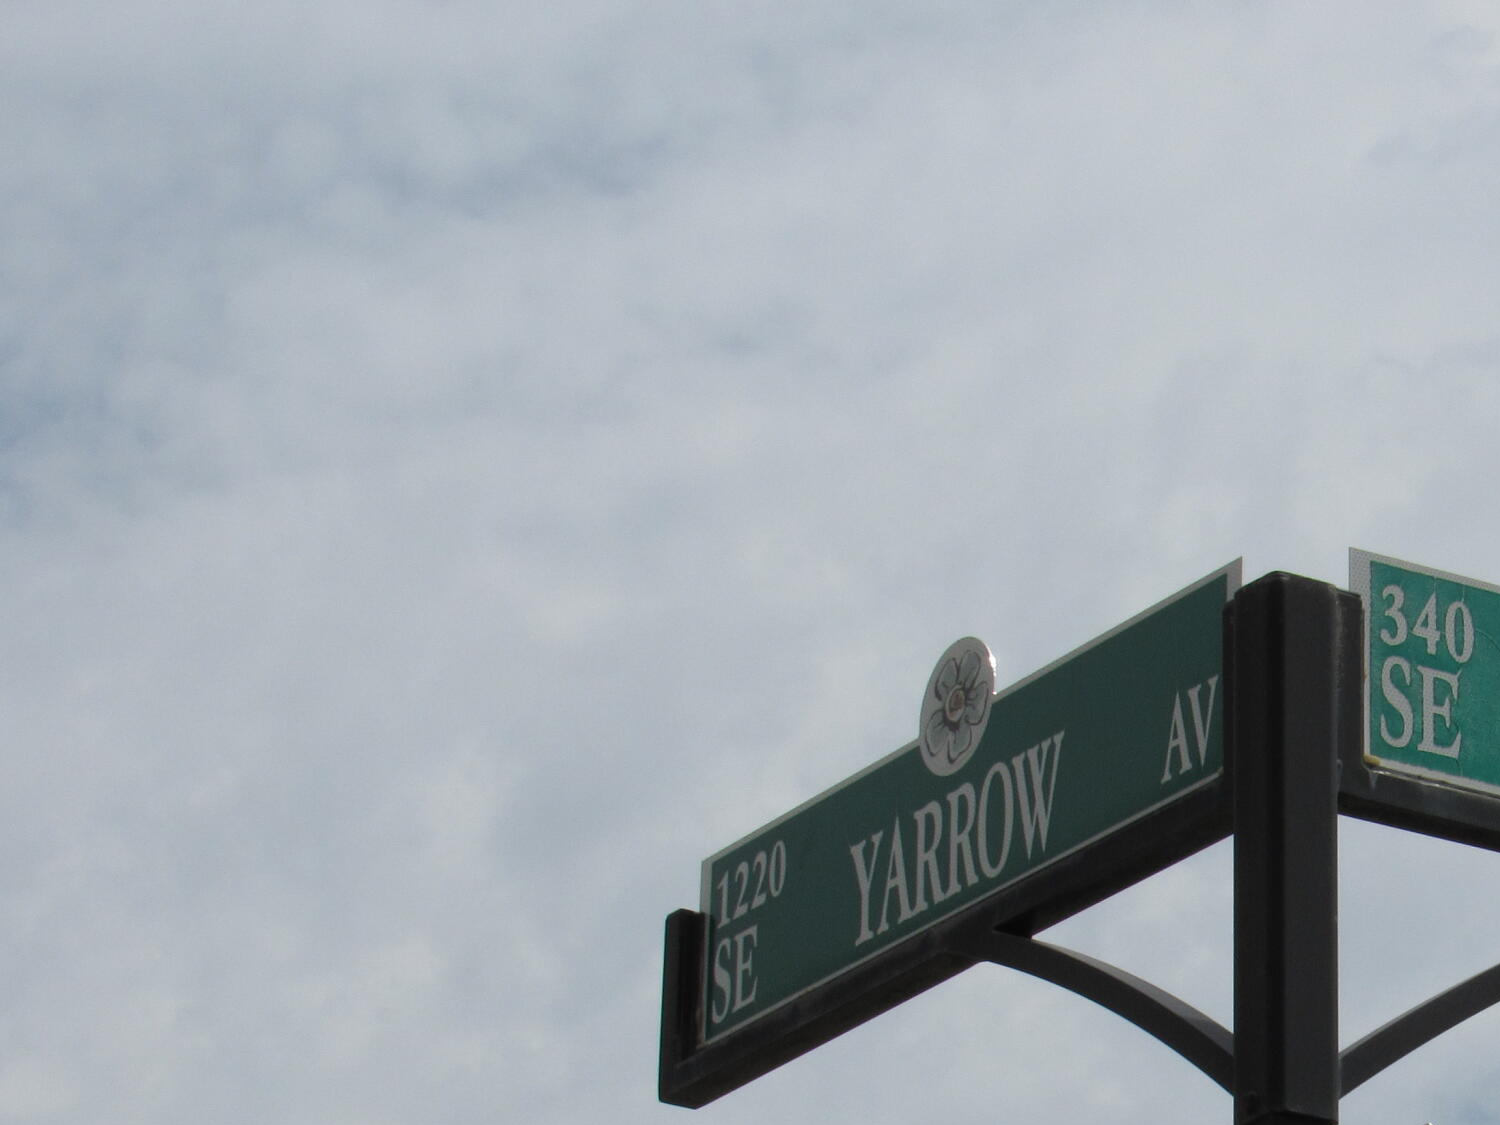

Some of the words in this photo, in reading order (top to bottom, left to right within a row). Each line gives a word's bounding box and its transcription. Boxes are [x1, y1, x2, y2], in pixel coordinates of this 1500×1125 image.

[1380, 585, 1475, 663] 340
[1380, 656, 1462, 758] SE
[711, 925, 758, 1026] SE
[850, 730, 1065, 947] YARROW
[1161, 674, 1219, 785] AV
[717, 840, 786, 929] 1220
